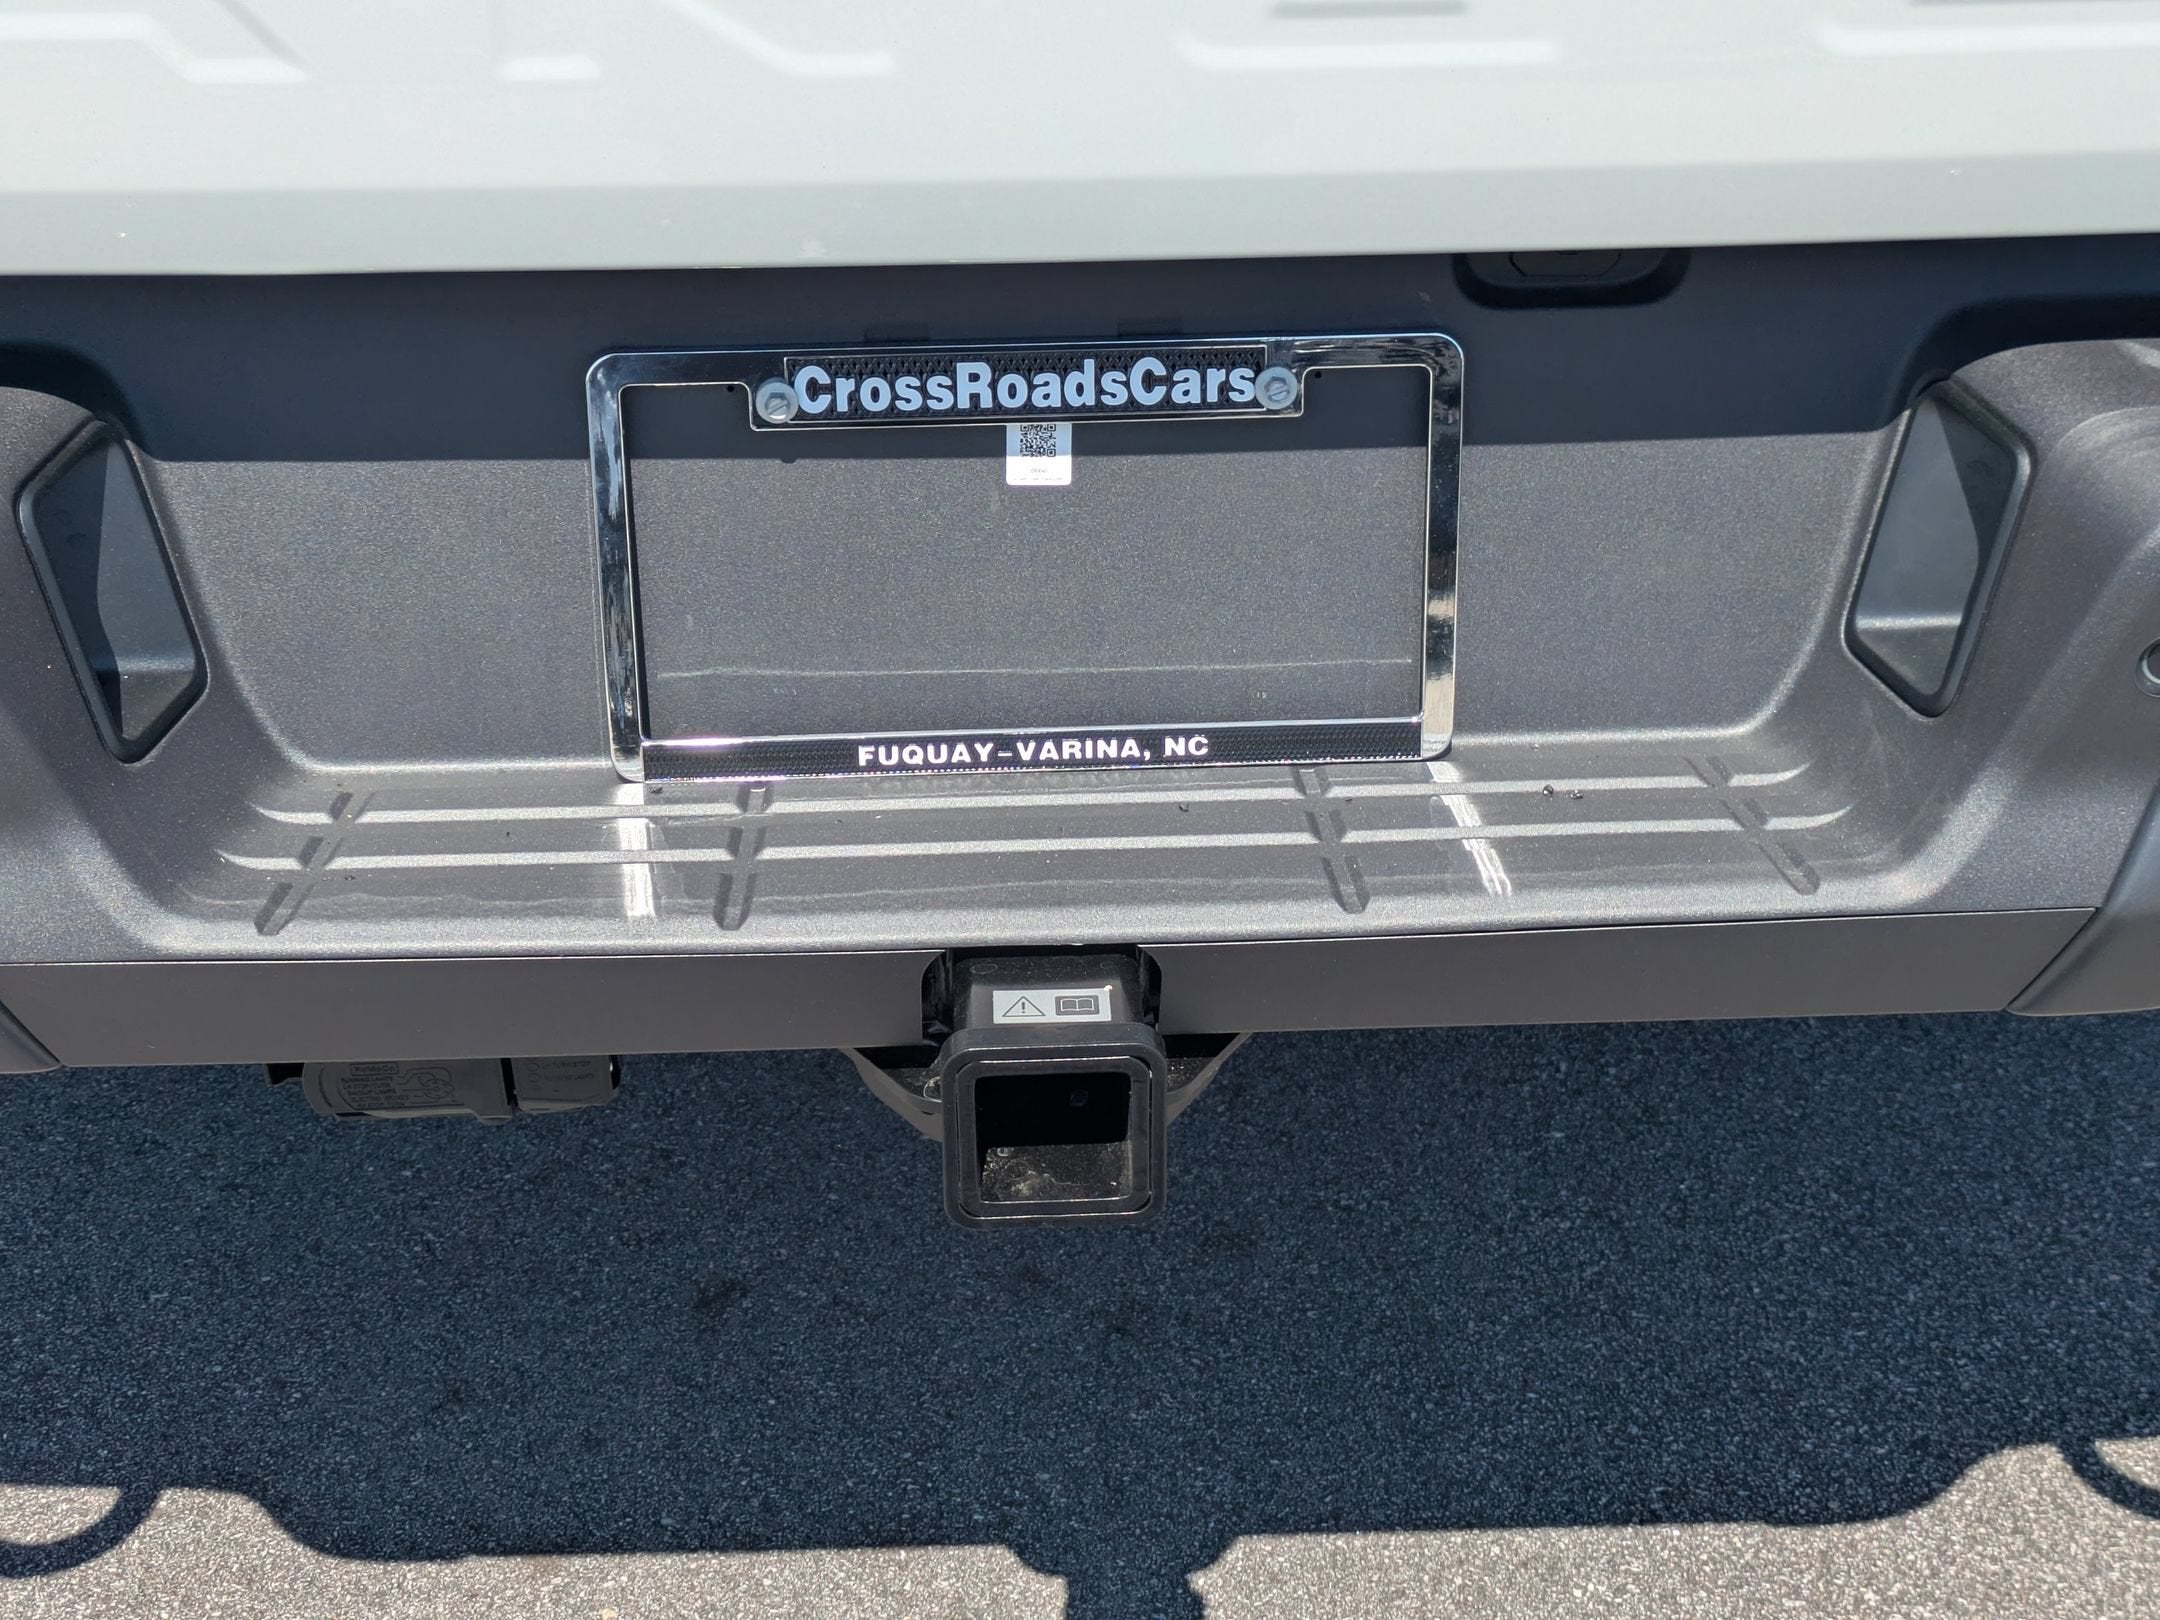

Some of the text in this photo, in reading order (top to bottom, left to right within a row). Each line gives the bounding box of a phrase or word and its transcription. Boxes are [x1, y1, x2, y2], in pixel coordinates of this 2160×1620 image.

[794, 355, 1256, 414] CrossRoadsCars
[858, 734, 1209, 767] FUQUAY-VARINA, NC
